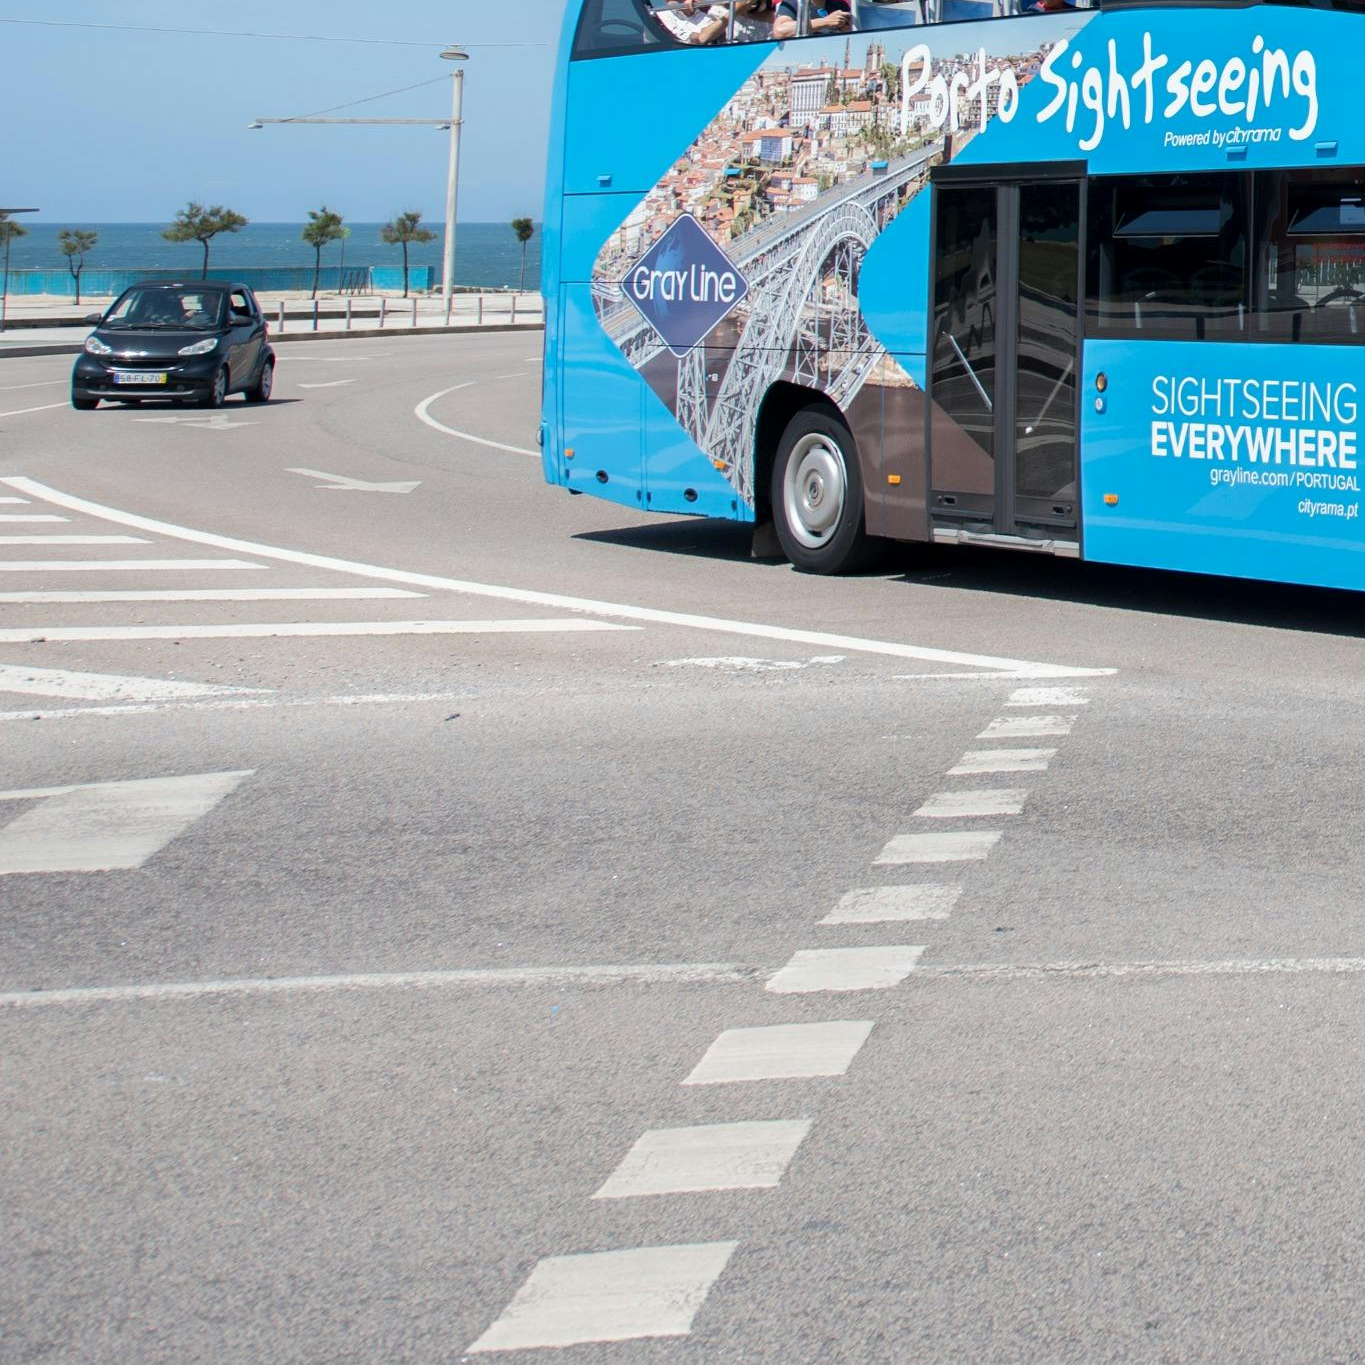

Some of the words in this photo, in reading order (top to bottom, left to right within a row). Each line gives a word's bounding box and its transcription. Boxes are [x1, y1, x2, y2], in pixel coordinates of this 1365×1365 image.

[901, 43, 1018, 134] Porto
[1037, 31, 1318, 151] Sightseeing
[1164, 129, 1211, 147] Powered
[1225, 126, 1282, 143] cityrama
[1152, 375, 1357, 424] SIGHTSEEING
[1151, 421, 1357, 469] EVERYWHERE
[1298, 498, 1358, 520] cityrama.pt
